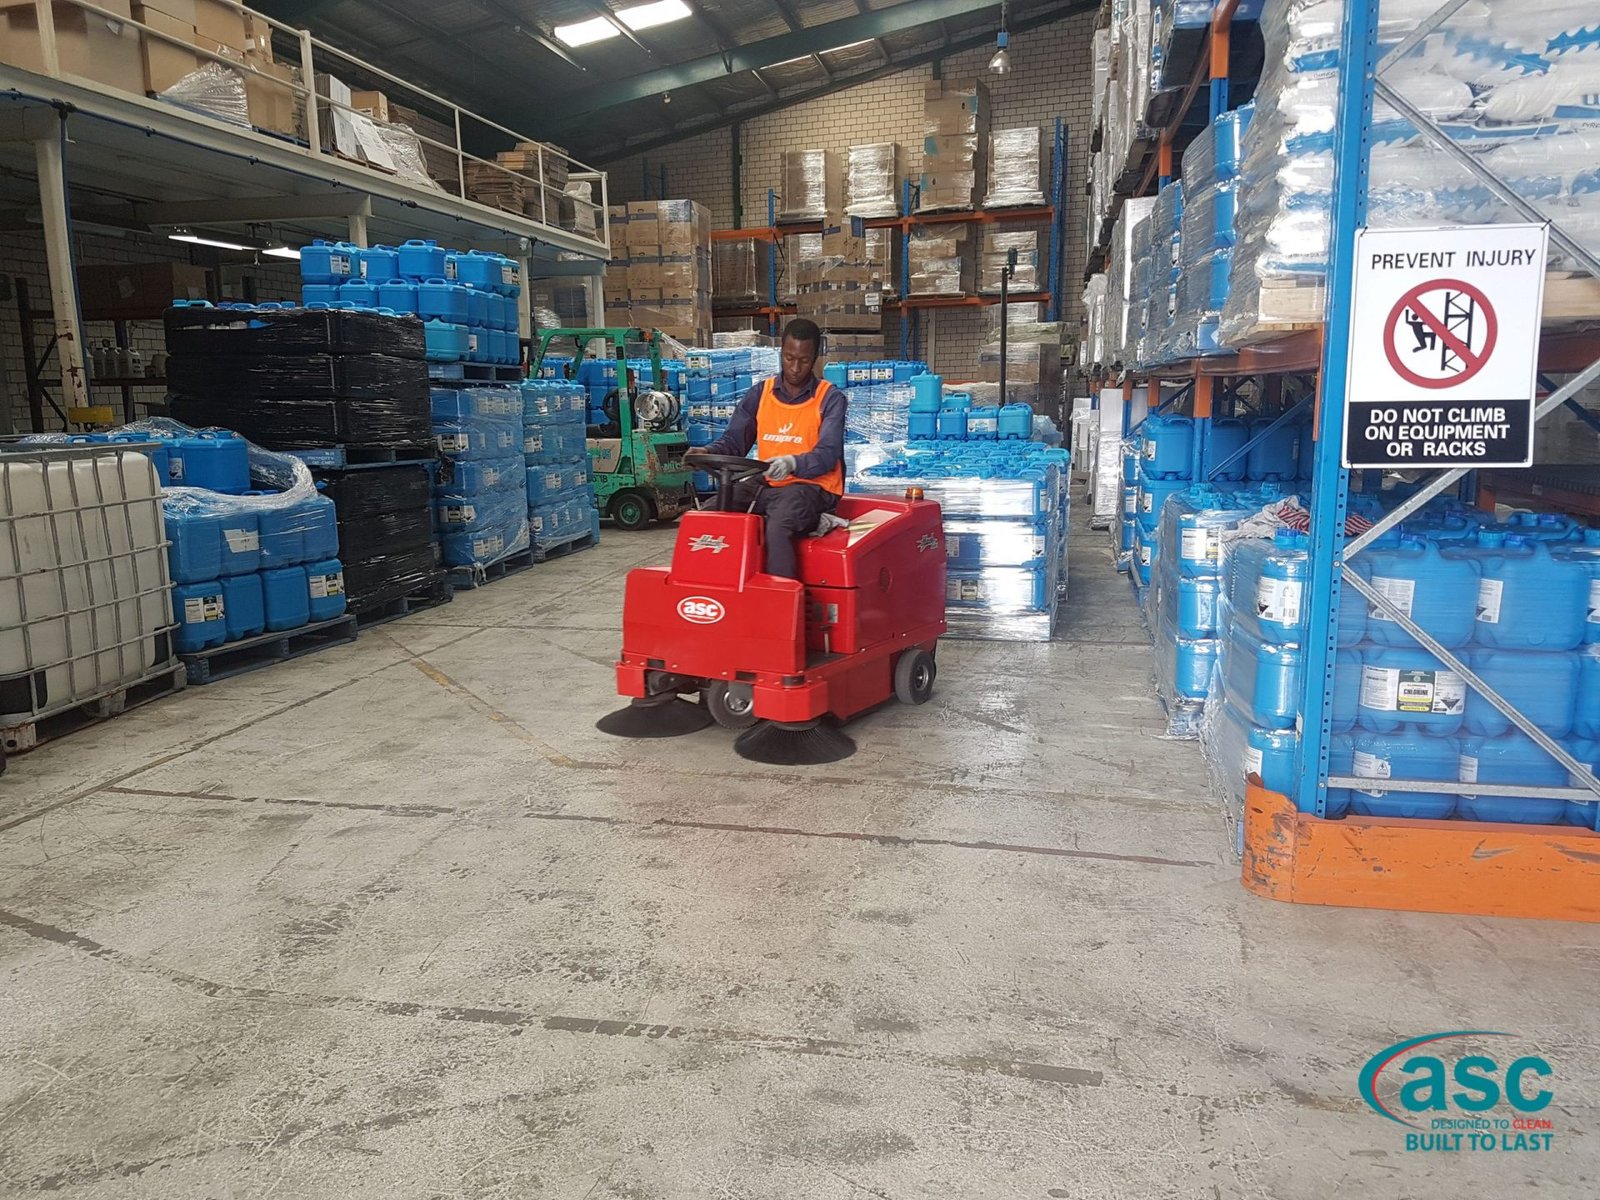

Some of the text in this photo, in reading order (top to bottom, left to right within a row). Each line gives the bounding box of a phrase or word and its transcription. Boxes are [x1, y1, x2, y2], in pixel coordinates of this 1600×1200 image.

[1371, 249, 1536, 270] PREVENT INJURY
[1370, 407, 1506, 424] DO NOT CLIMB
[1364, 424, 1510, 440] ON EQUIPMENT
[1386, 441, 1486, 456] OR RACKS
[683, 601, 718, 617] asc
